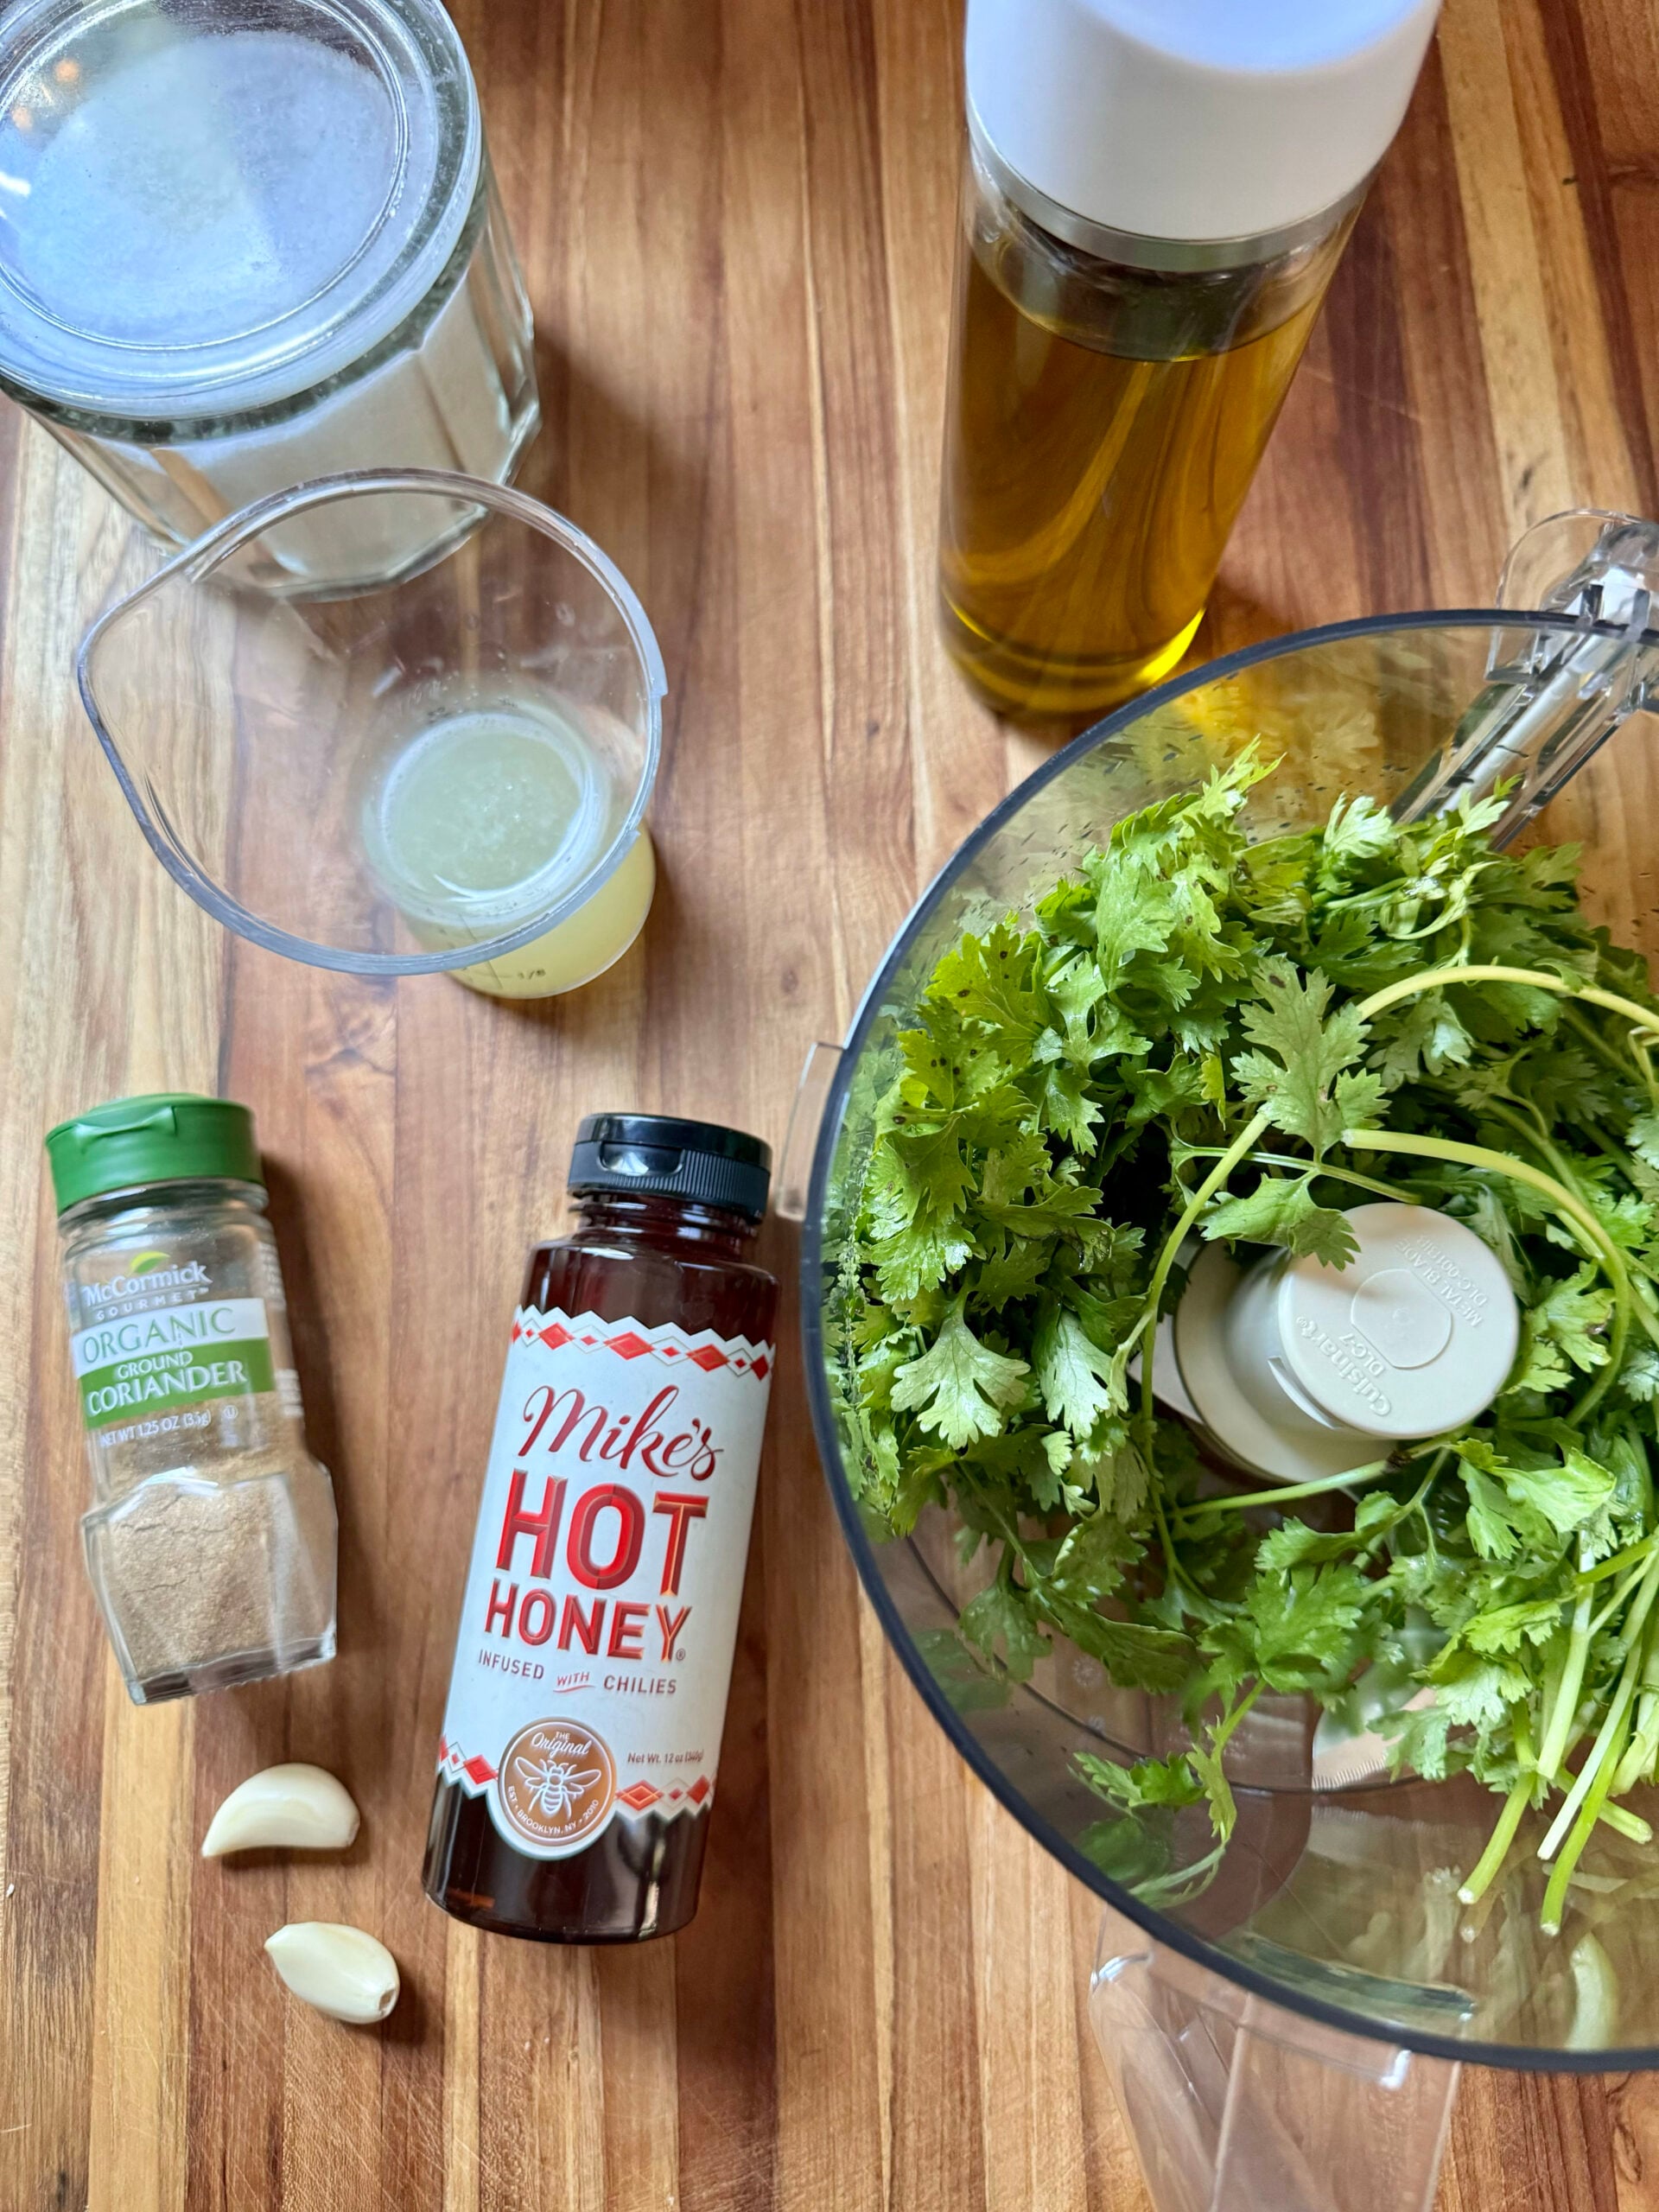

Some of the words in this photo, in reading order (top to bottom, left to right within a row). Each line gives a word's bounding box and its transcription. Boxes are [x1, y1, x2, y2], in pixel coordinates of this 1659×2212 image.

[82, 1261, 213, 1306] McCormick
[1440, 1284, 1484, 1328] METAL
[83, 1307, 236, 1363] ORGANIC
[1338, 1332, 1387, 1378] DLC-7
[115, 1351, 194, 1380] GROUND
[86, 1360, 248, 1416] CORIANDER
[99, 1431, 118, 1448] NET
[118, 1426, 137, 1440] WT
[161, 1415, 180, 1431] OZ
[518, 1384, 724, 1481] Mike's
[495, 1468, 710, 1597] HOT
[479, 1649, 545, 1680] INFUSED
[556, 1672, 590, 1687] WITH
[603, 1674, 677, 1694] CHILIES
[531, 1732, 592, 1758] Original
[556, 1731, 570, 1739] THE
[627, 1752, 645, 1764] Net
[664, 1752, 674, 1764] 12
[564, 1821, 576, 1832] NY
[582, 1799, 599, 1819] 2010
